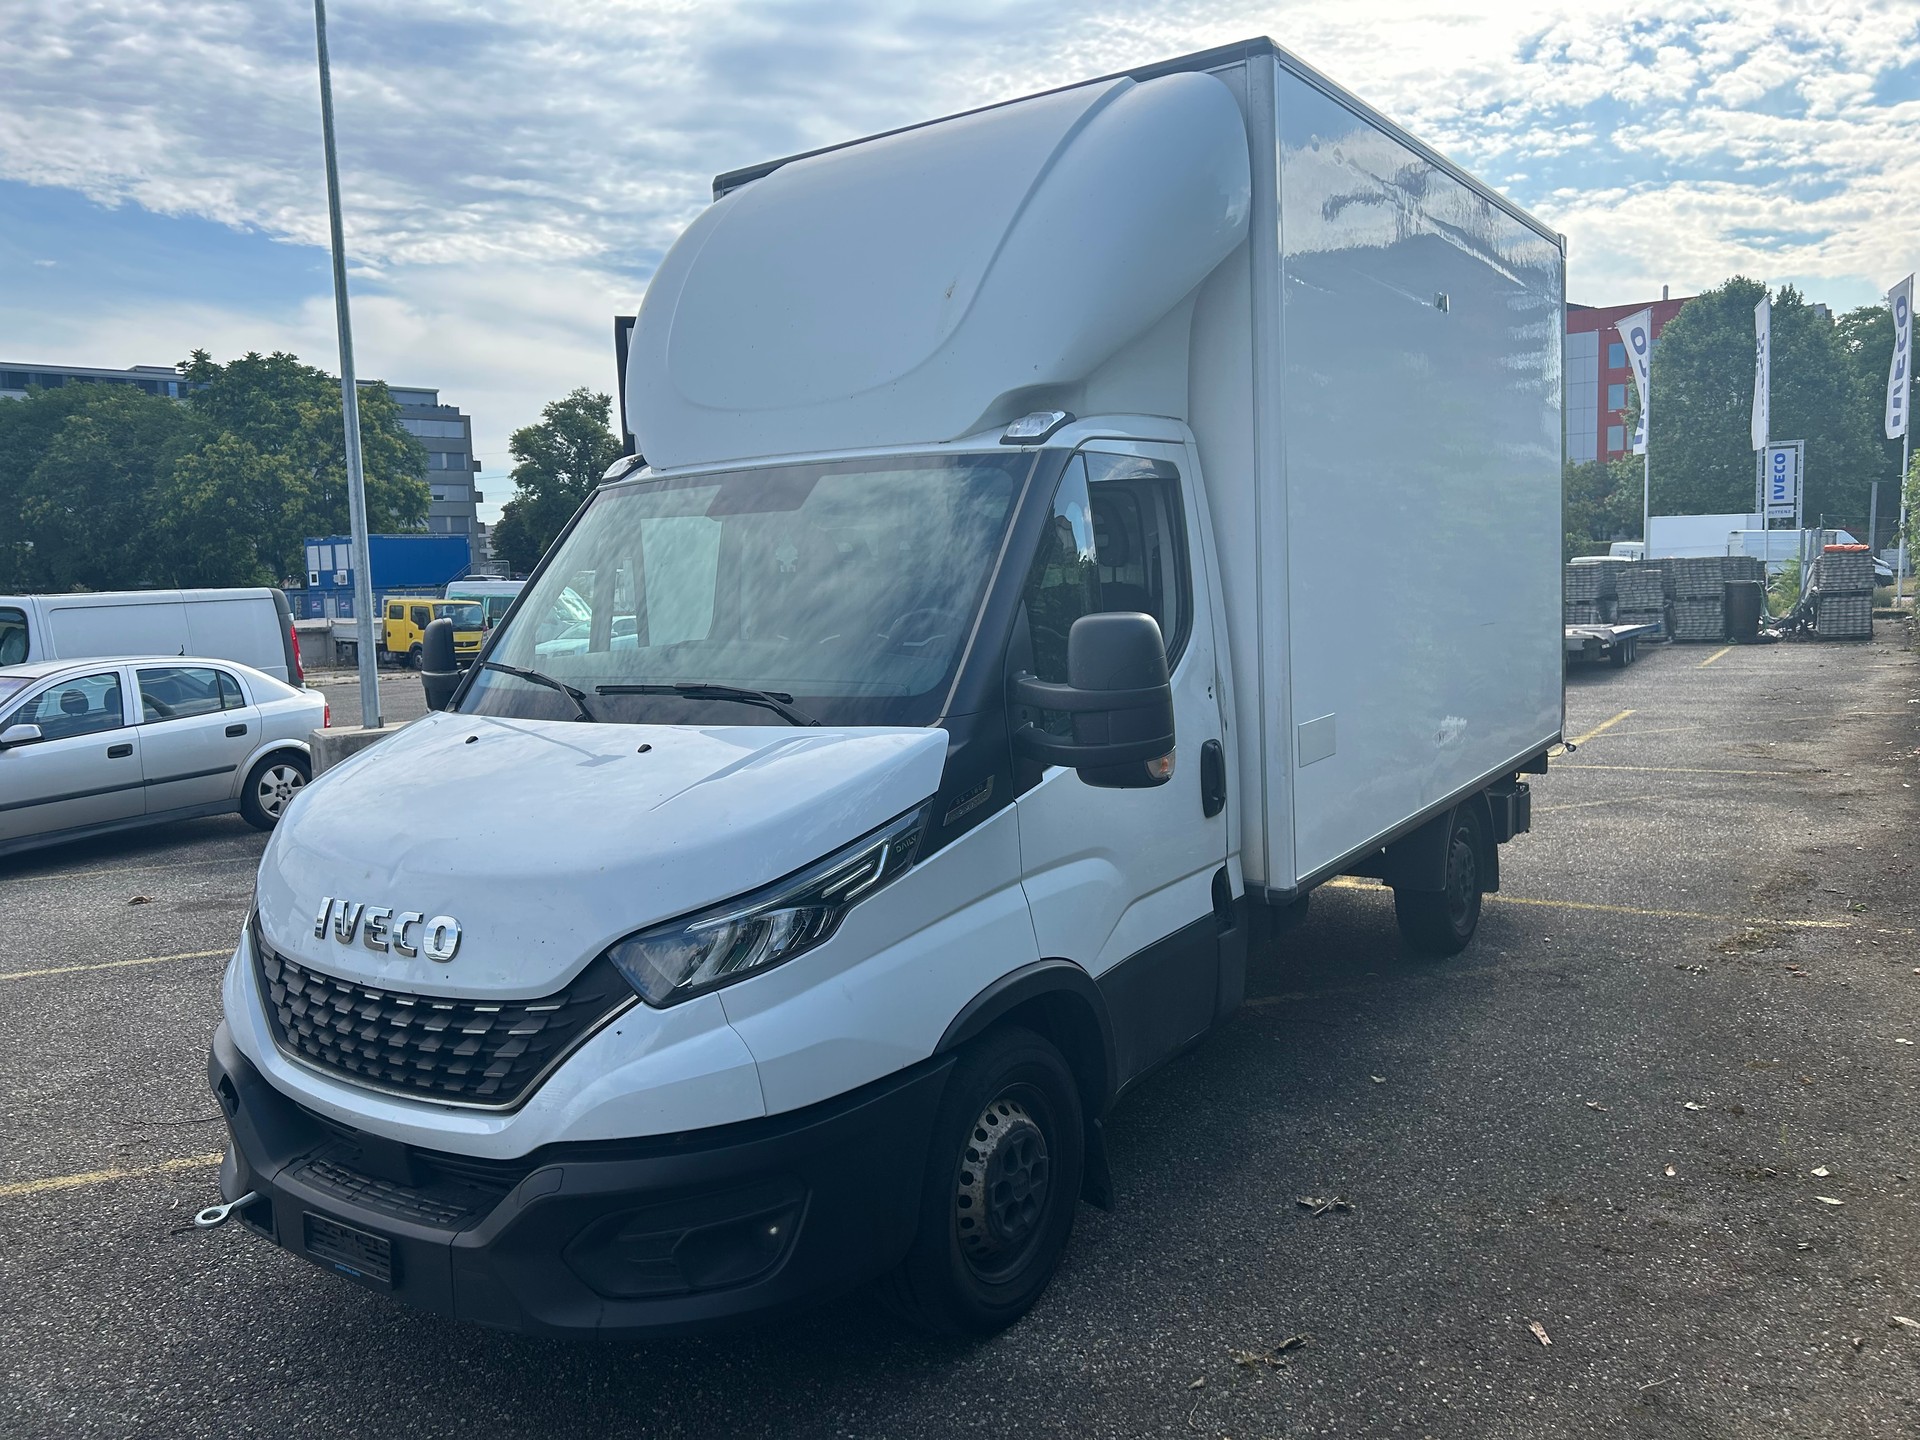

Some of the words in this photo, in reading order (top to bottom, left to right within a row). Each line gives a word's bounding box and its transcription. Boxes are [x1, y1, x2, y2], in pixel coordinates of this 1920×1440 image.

[1773, 453, 1786, 500] IVECO
[895, 835, 918, 853] DAILY
[313, 896, 463, 963] IVECO
